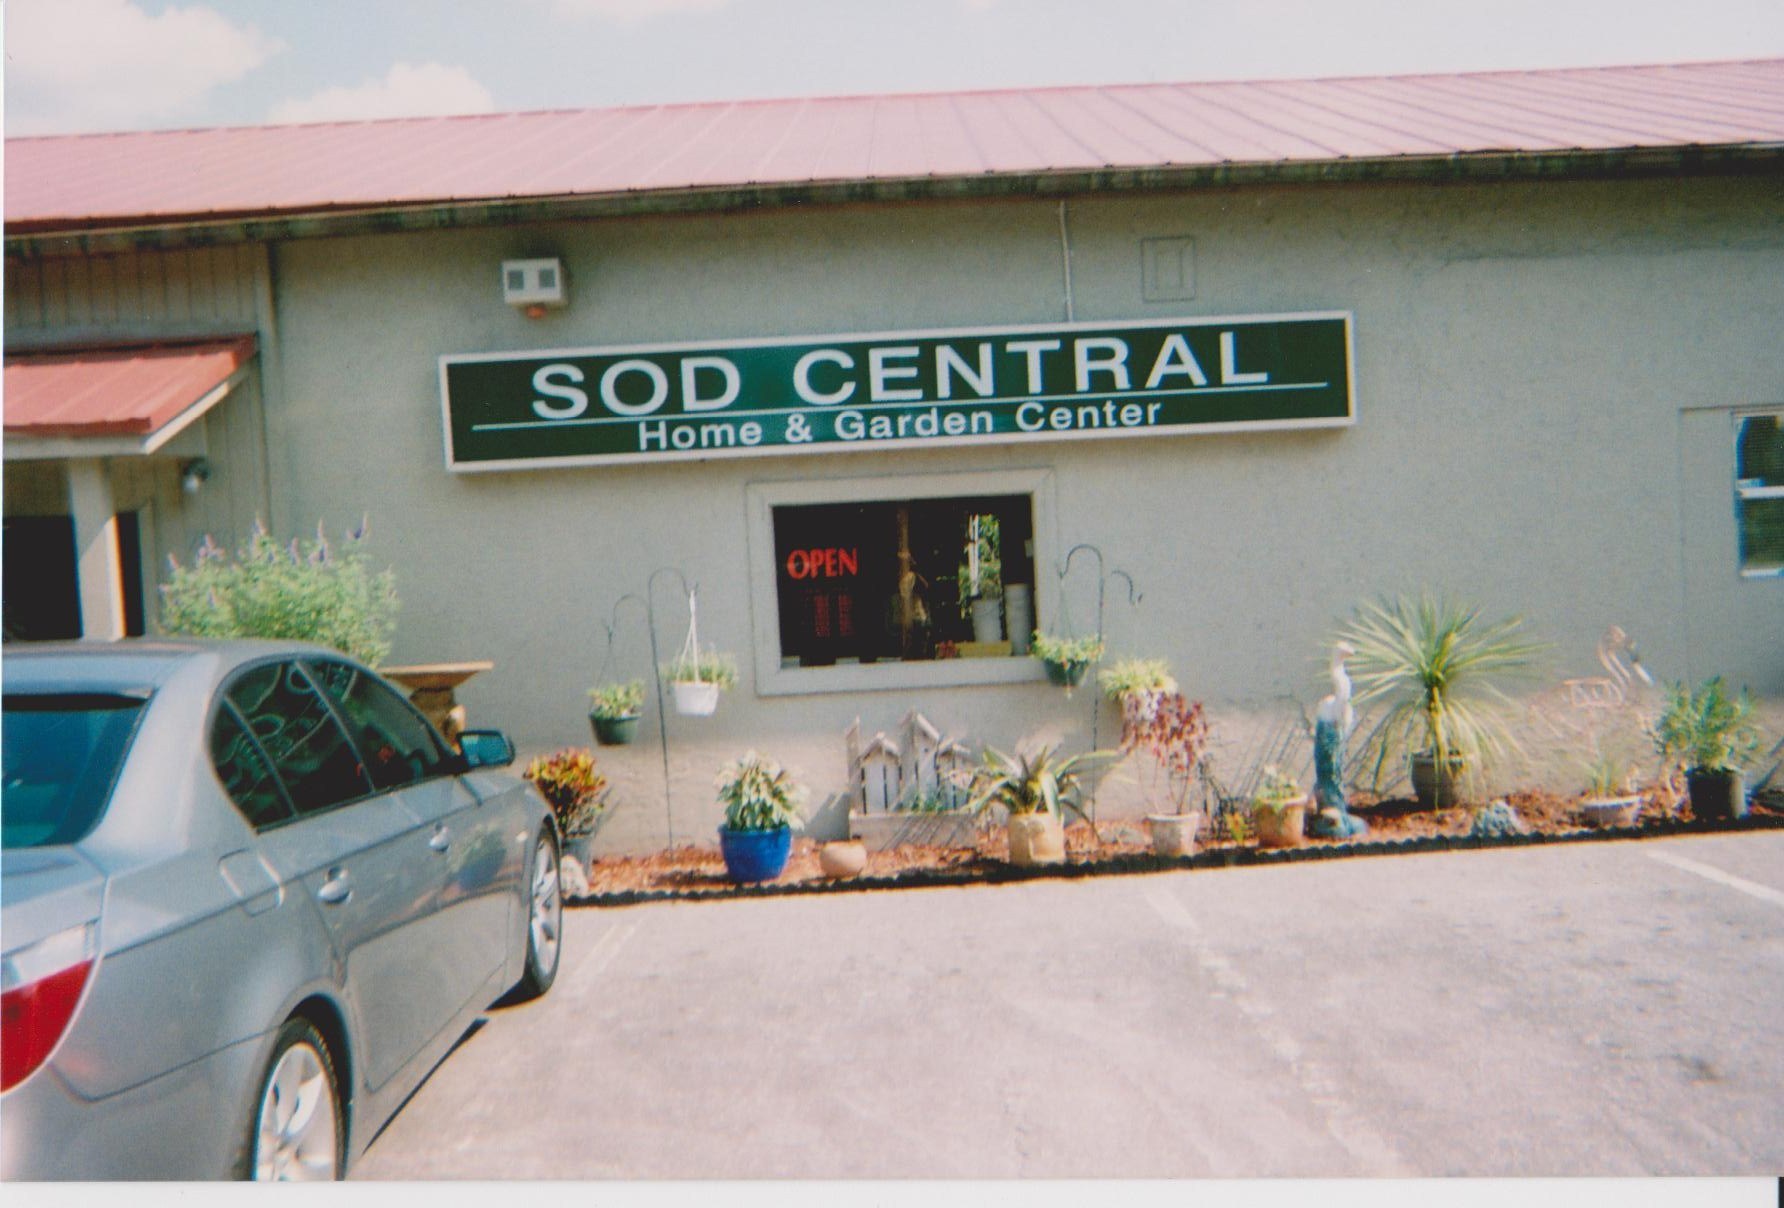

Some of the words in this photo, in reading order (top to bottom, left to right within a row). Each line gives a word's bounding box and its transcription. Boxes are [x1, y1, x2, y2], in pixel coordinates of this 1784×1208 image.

[532, 356, 741, 419] SOD
[792, 331, 1268, 405] CENTRAL
[638, 420, 763, 451] Home
[784, 413, 813, 443] &
[834, 407, 994, 440] Garden
[1015, 401, 1162, 432] Center
[787, 548, 858, 580] OPEN
